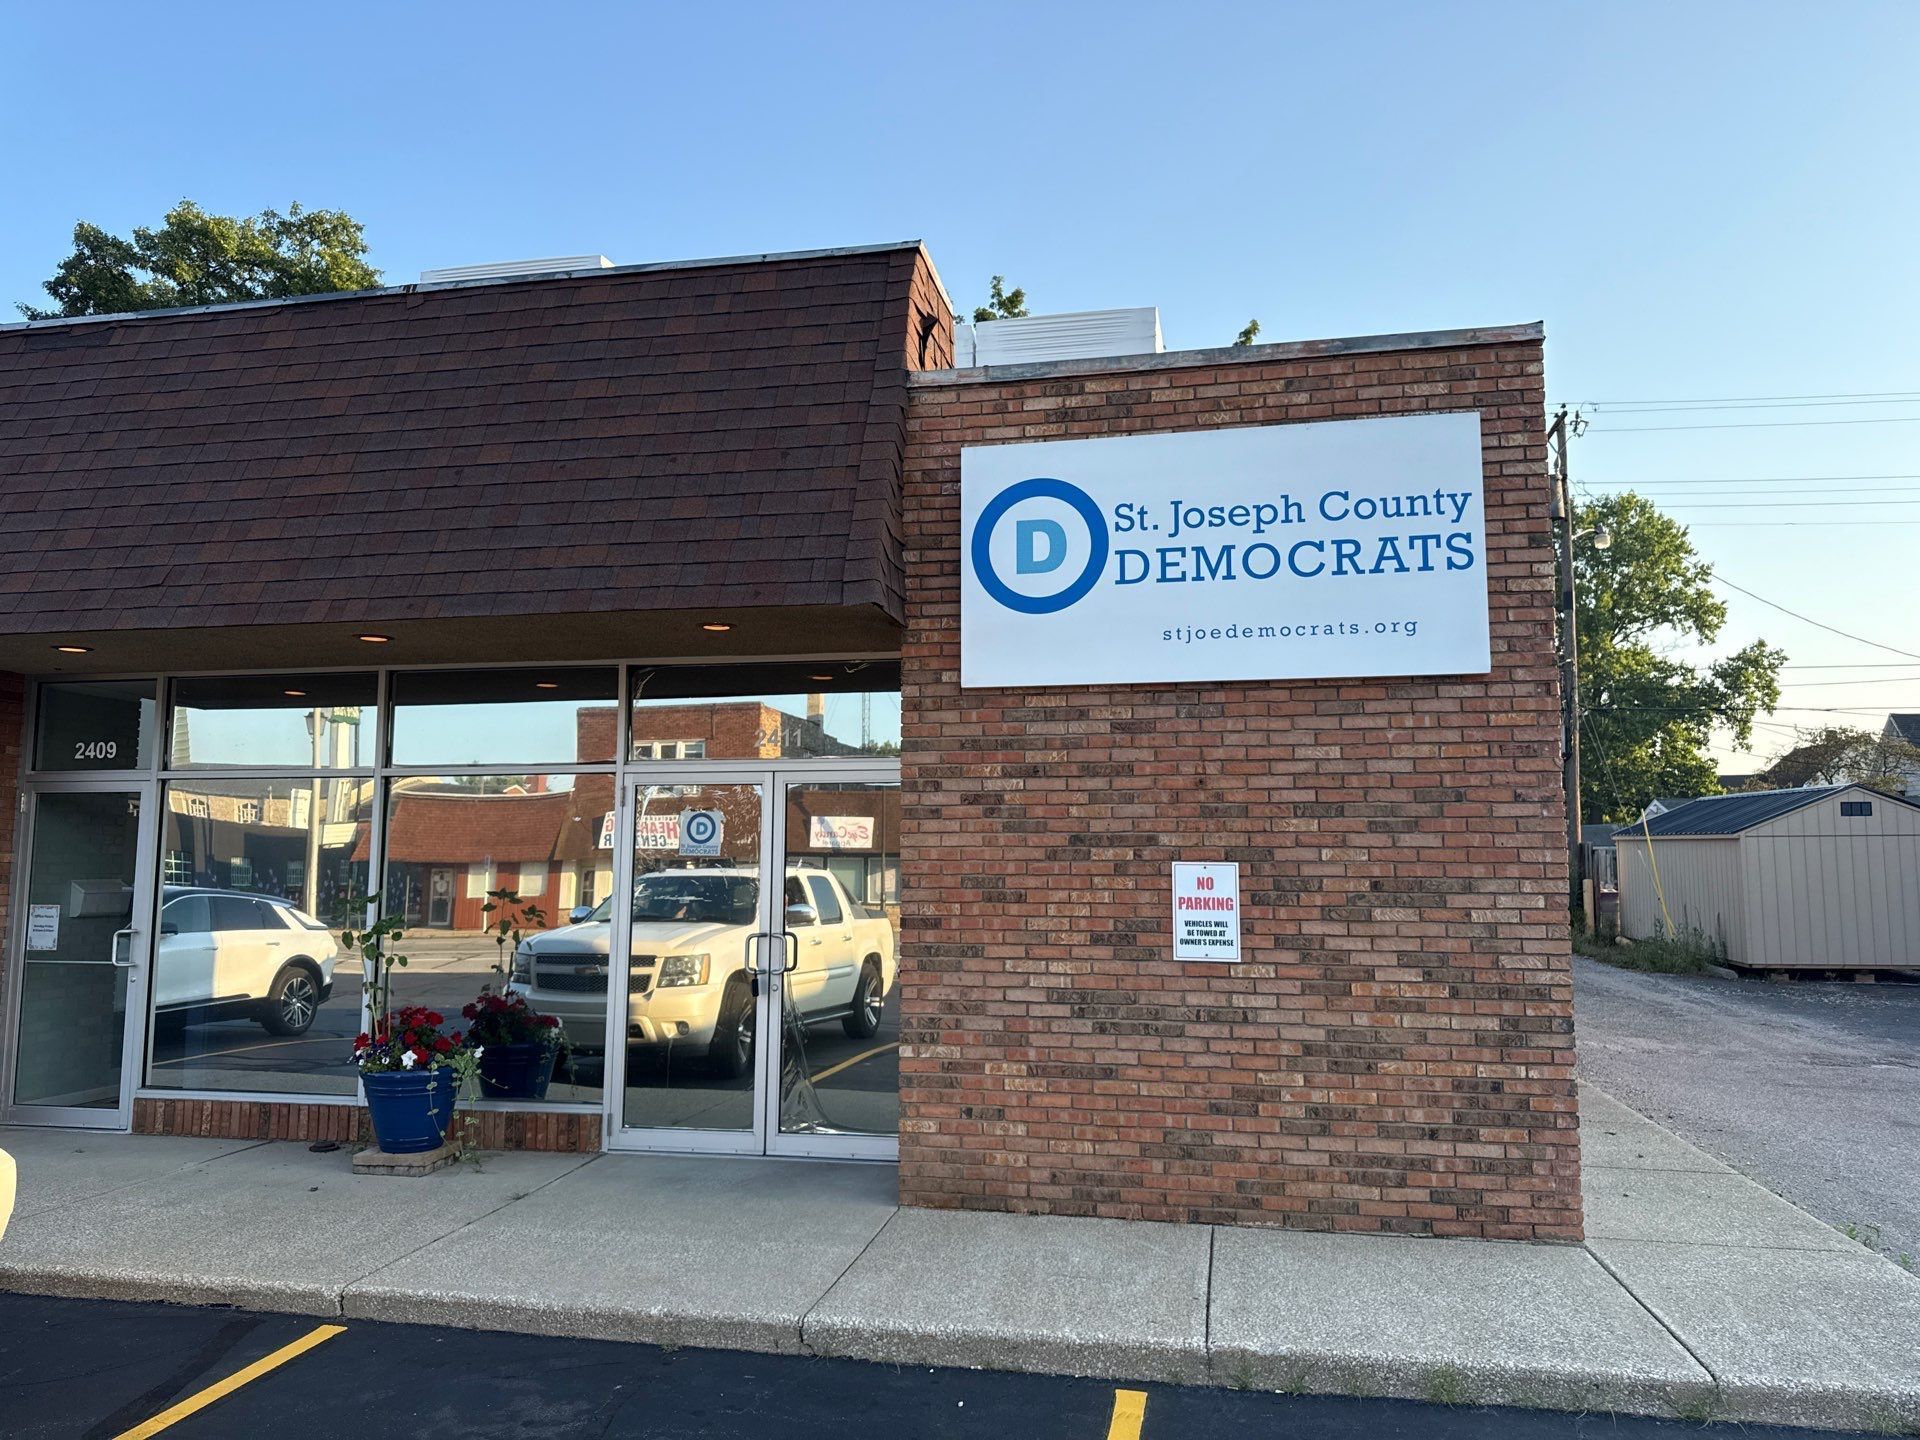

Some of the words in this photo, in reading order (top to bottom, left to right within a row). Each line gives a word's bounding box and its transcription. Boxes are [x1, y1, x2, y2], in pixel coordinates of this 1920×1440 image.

[1114, 502, 1159, 533] St.
[1167, 494, 1306, 538] Joseph
[1318, 487, 1473, 524] County
[1015, 518, 1068, 575] D
[1114, 532, 1475, 586] DEMOCRATS
[1162, 617, 1419, 645] stjoedemocrats.org
[753, 728, 802, 748] 2411
[74, 741, 117, 759] 2409
[695, 821, 709, 836] D
[1196, 876, 1215, 891] NO
[1177, 896, 1235, 911] PARKING
[1184, 920, 1213, 928] VEHICLES
[1213, 920, 1229, 929] WILL
[1186, 929, 1196, 937] BE
[1196, 929, 1218, 937] TOWED
[1179, 938, 1208, 946] OWNER'S
[1208, 938, 1235, 947] EXPENSE
